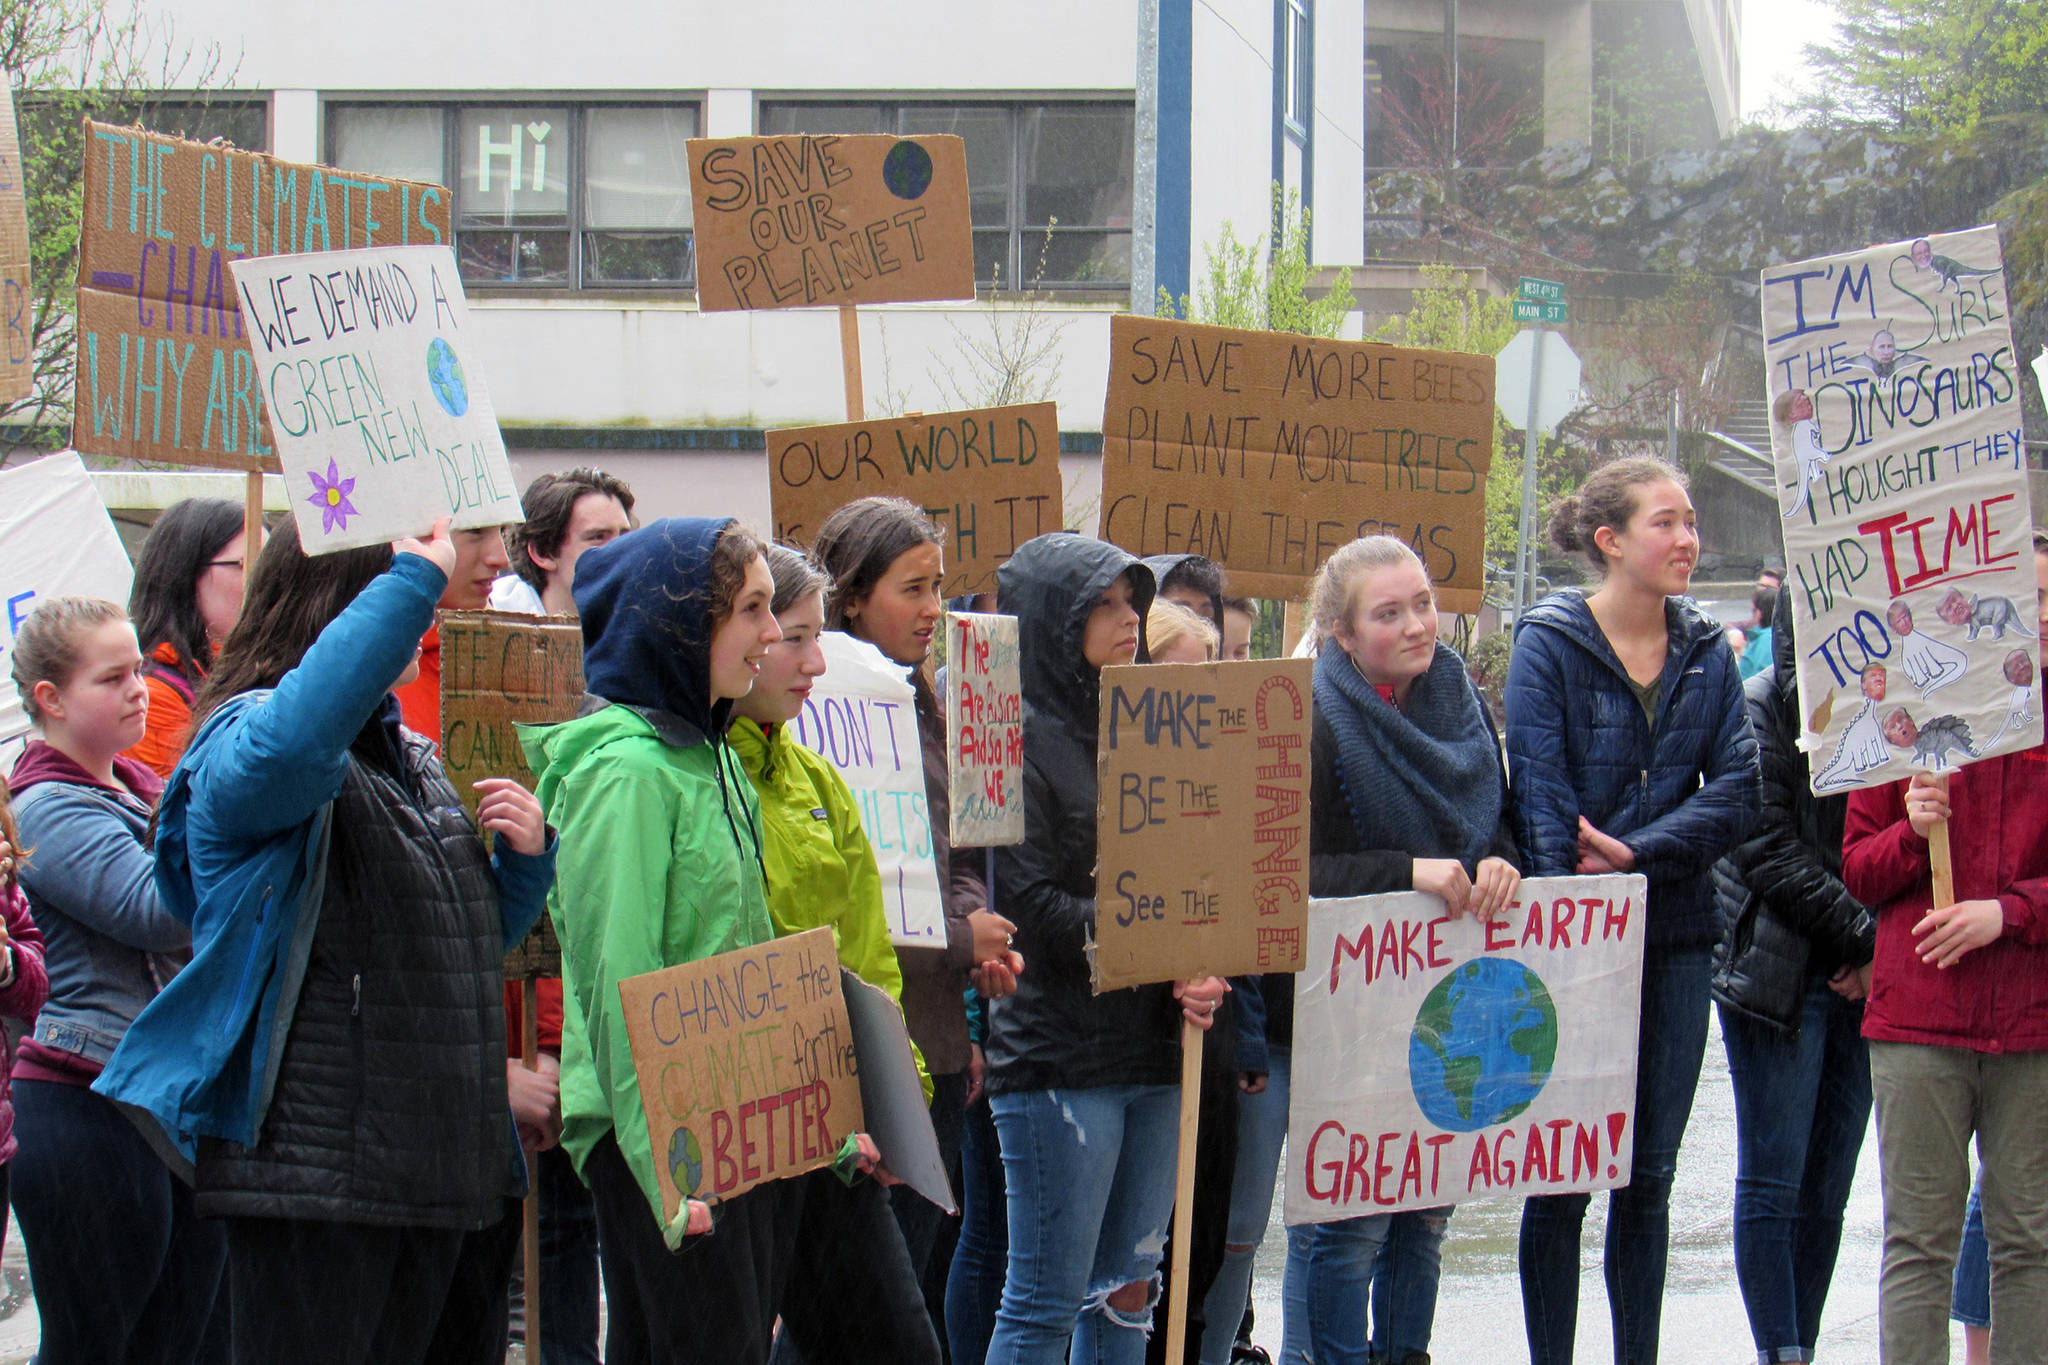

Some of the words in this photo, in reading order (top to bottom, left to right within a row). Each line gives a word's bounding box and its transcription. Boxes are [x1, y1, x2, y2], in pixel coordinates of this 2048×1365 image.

[93, 132, 175, 240] THE
[200, 153, 390, 257] CLIMATE
[400, 186, 442, 247] IS
[478, 121, 552, 192] Hi
[701, 135, 853, 212] SAVE
[722, 206, 927, 311] PLANET
[749, 193, 847, 252] OUR
[241, 274, 311, 353] WE
[308, 262, 419, 341] DEMAND
[430, 264, 457, 329] A
[1518, 304, 1540, 318] MAIN
[1547, 306, 1559, 319] ST
[1763, 262, 1878, 346] I'M
[1888, 254, 2005, 352] SURE
[87, 332, 195, 449] WHY
[270, 350, 389, 438] GREEN
[1131, 336, 1244, 393] SAVE
[1281, 345, 1398, 401] MORE
[1412, 358, 1489, 406] BEES
[1776, 341, 1853, 391] THE
[1814, 346, 2014, 456] DINOSAURS
[359, 401, 432, 466] NEW
[779, 430, 885, 488] OUR
[895, 417, 1038, 477] WORLD
[1127, 406, 1261, 479] PLANT
[1269, 420, 1369, 485] MORE
[1372, 428, 1479, 496] TREES
[1942, 428, 2022, 474] THEY
[434, 439, 512, 515] DEAL
[1105, 494, 1232, 564] CLEAN
[1261, 511, 1346, 571] THE
[1795, 538, 1869, 621] HAD
[1857, 492, 2020, 600] TIME
[447, 630, 490, 701] IF
[957, 619, 990, 676] The
[1808, 610, 1893, 689] TOO
[796, 696, 901, 772] DON'T
[960, 680, 985, 725] Are
[1107, 684, 1216, 750] MAKE
[1216, 708, 1247, 729] THE
[446, 719, 503, 772] CAN
[959, 725, 987, 768] And
[984, 769, 1006, 808] WE
[1118, 773, 1168, 835] BE
[1175, 779, 1219, 809] THE
[1251, 674, 1303, 967] CHANGE
[1114, 870, 1166, 928] See
[1180, 889, 1220, 917] THE
[1329, 915, 1453, 995] MAKE
[1483, 896, 1631, 952] EARTH
[651, 952, 788, 1047] CHANGE
[796, 947, 833, 1005] the
[660, 1024, 790, 1123] CLIMATE
[793, 1022, 822, 1086] for
[1304, 1119, 1456, 1206] GREAT
[1467, 1111, 1627, 1194] AGAIN!
